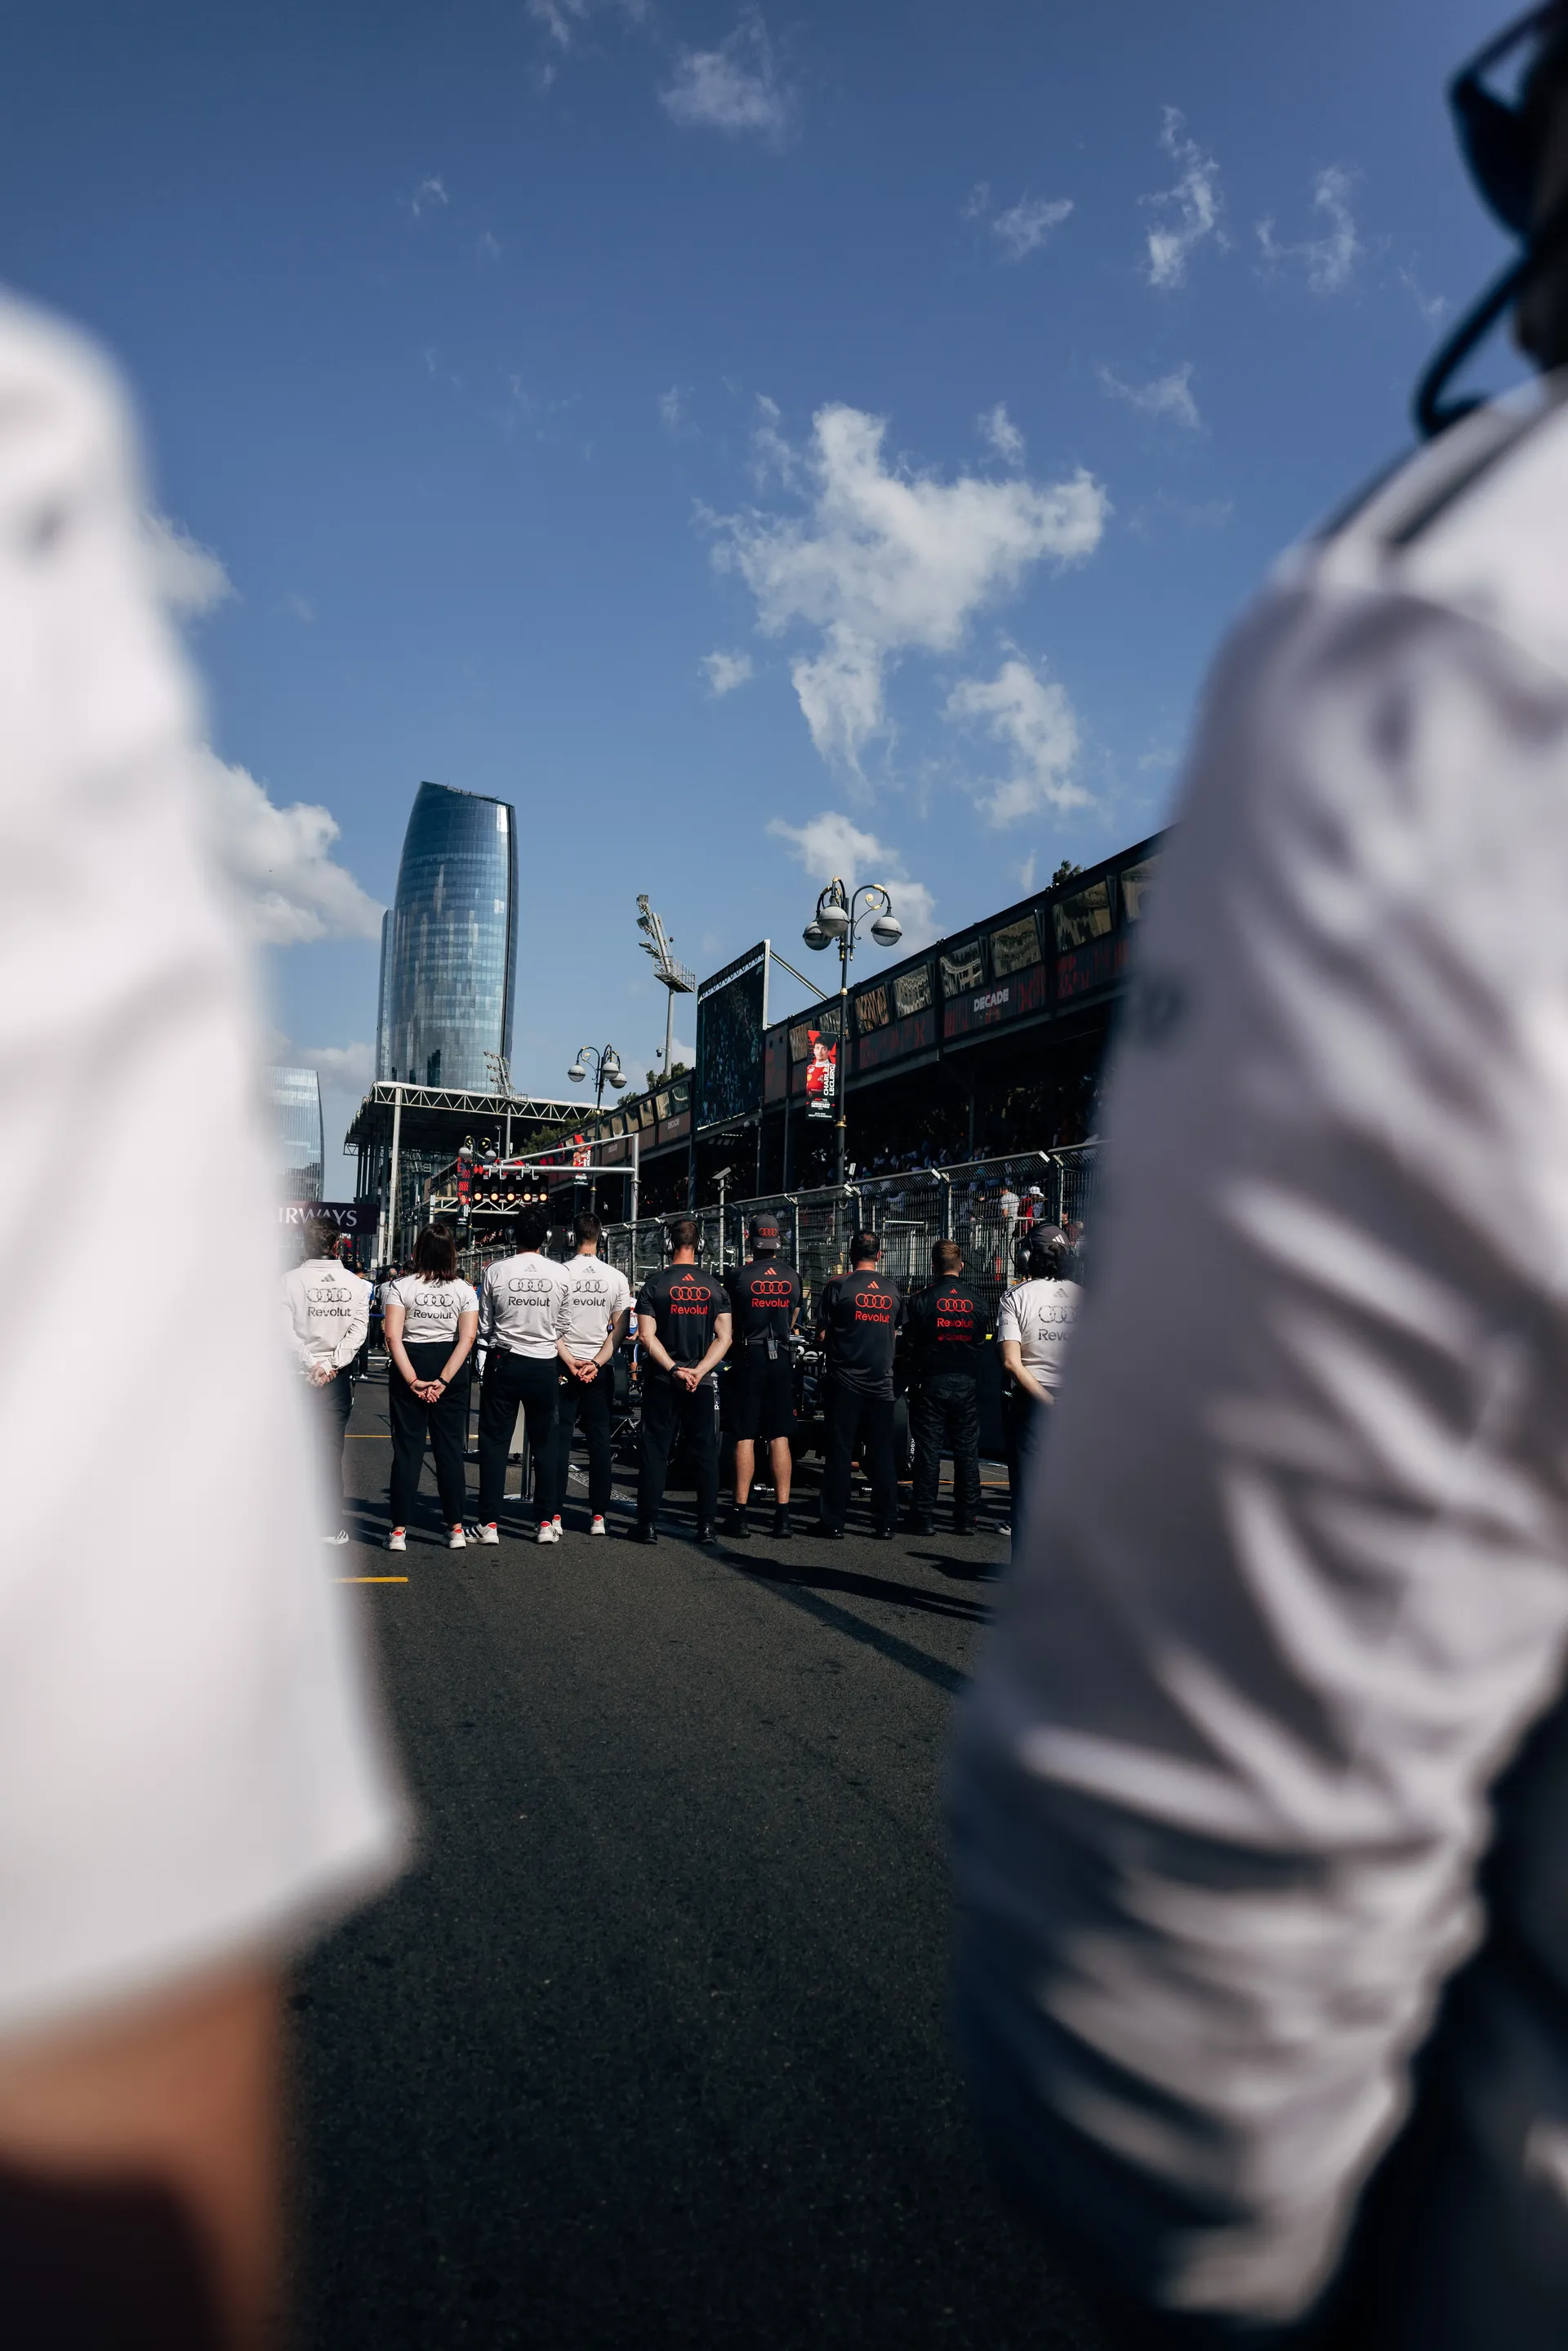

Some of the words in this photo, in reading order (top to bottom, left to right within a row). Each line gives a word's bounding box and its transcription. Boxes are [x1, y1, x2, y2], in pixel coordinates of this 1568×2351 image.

[973, 988, 1009, 1013] DECADE
[508, 1296, 550, 1307] Revolut
[751, 1298, 790, 1307] Revolut
[307, 1307, 352, 1317] Revolut
[413, 1309, 453, 1320] Revolut
[670, 1304, 708, 1315] Revolut
[855, 1311, 890, 1323] Revolut
[937, 1317, 973, 1329] Revolut
